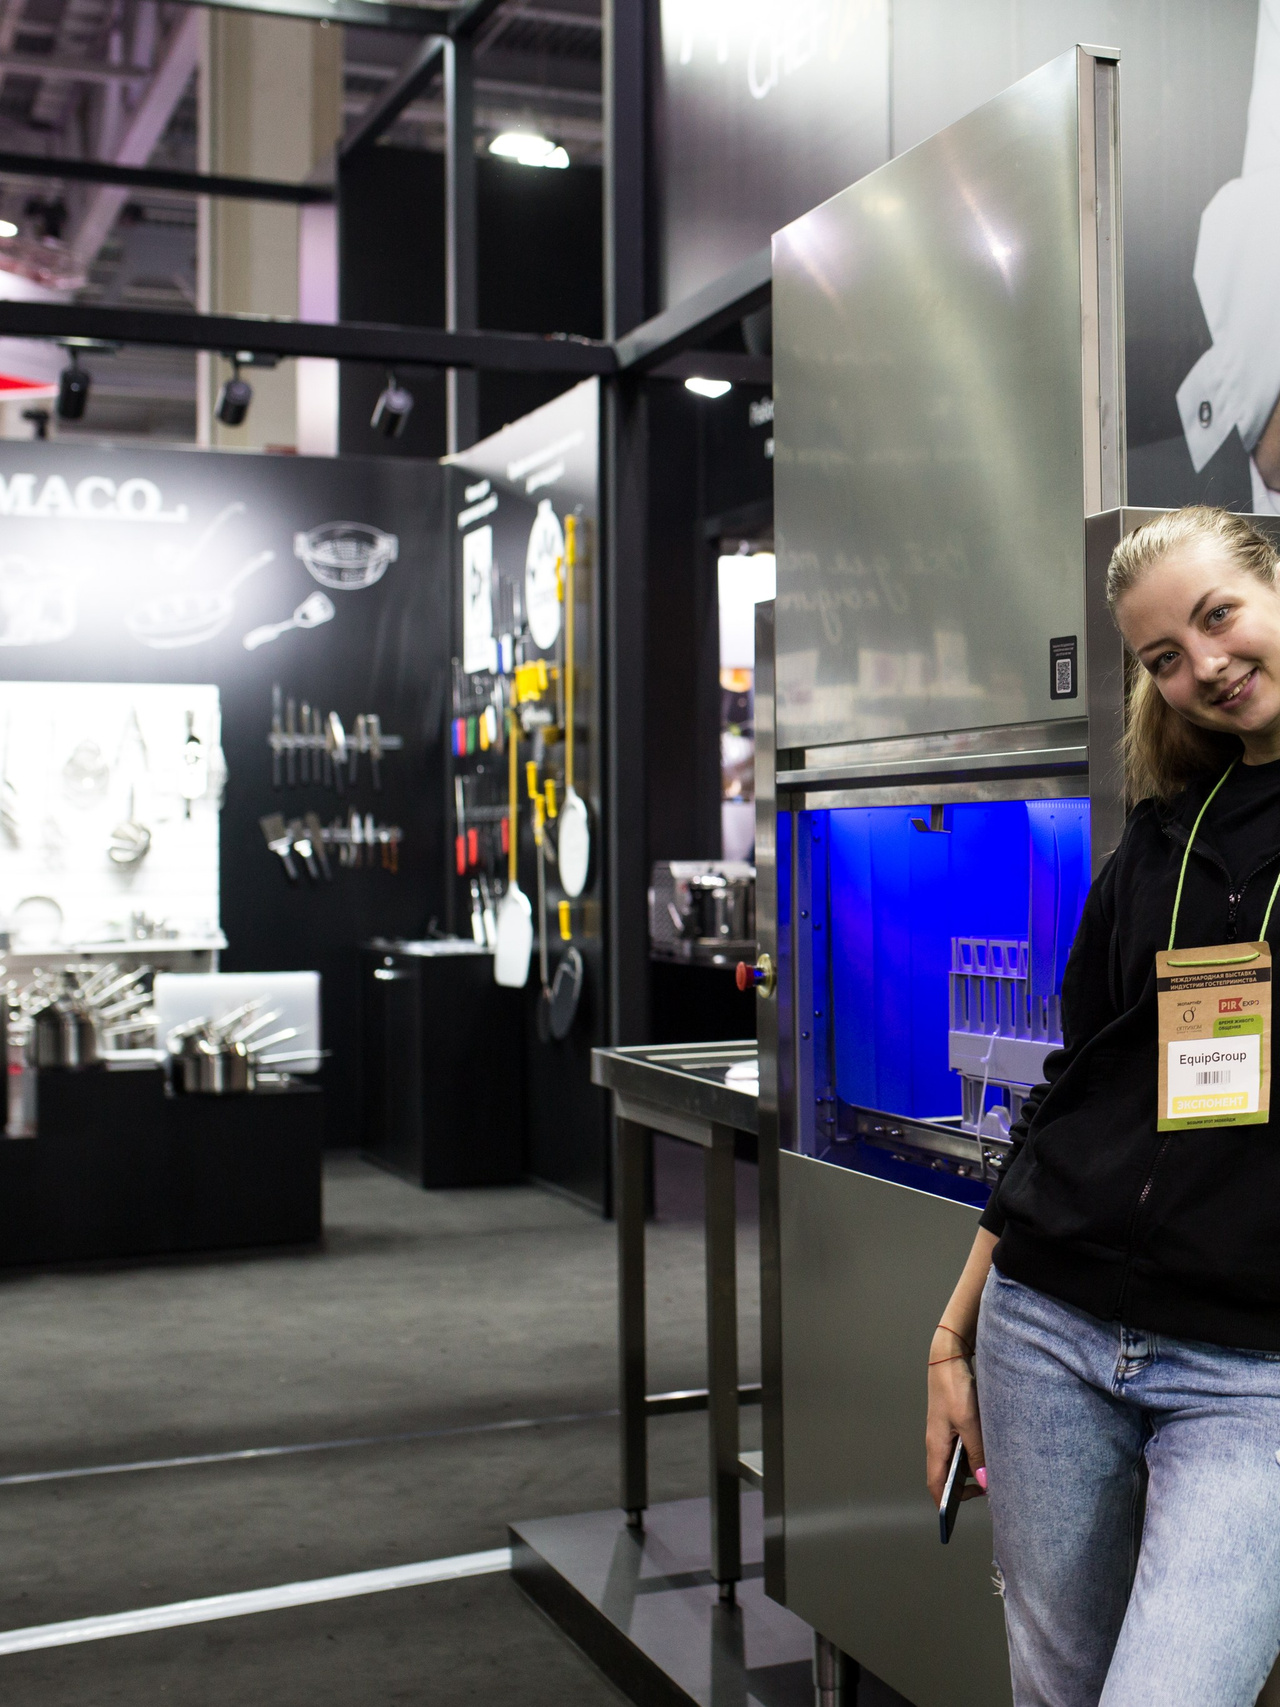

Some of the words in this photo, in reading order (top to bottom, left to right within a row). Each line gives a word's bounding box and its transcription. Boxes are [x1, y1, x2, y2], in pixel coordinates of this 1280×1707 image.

[1170, 973, 1224, 984] МЕЖДУНАРОДНАЯ
[1225, 970, 1256, 978] ВЫСТАВКА
[1170, 981, 1204, 990] ИНДУСТРИИ
[1205, 977, 1257, 987] ГОСТЕПРИИМСТВА
[1221, 1001, 1237, 1011] PIR
[1180, 1052, 1247, 1066] EquipGroup
[1177, 1096, 1244, 1111] ЭКСПОНЕНТ
